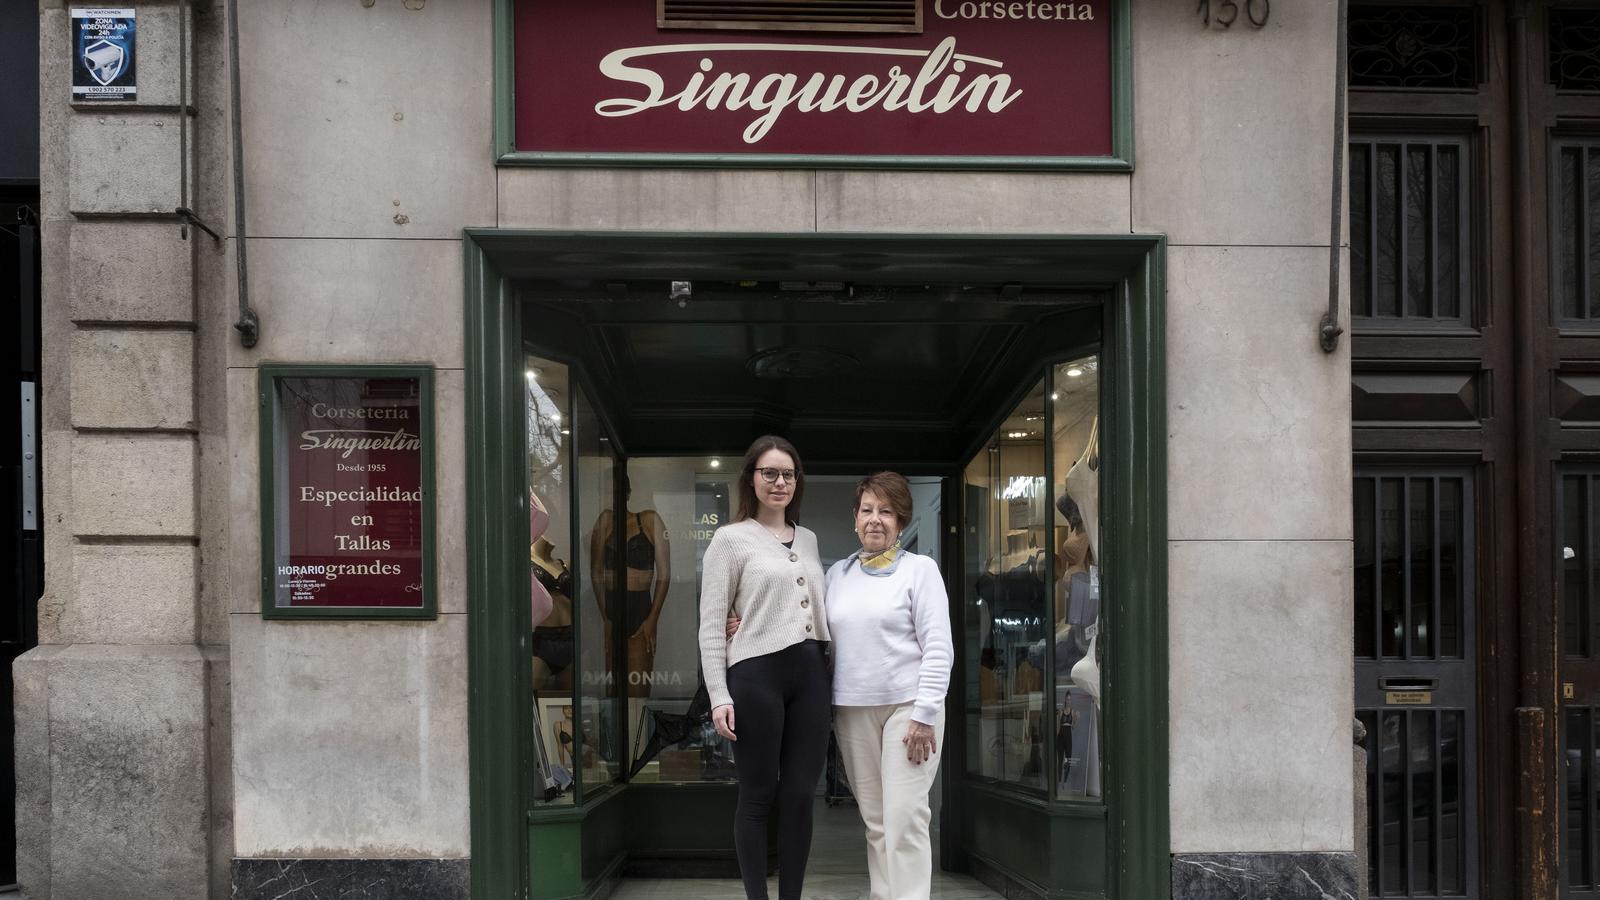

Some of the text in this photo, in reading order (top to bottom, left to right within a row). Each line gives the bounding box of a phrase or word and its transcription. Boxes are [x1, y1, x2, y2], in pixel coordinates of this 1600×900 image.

[934, 0, 1095, 22] Corseteria
[594, 35, 1023, 144] Singuerlin
[311, 402, 410, 420] Corseteria
[299, 427, 422, 459] Singuerlin
[337, 463, 386, 472] Desde 1955
[299, 486, 422, 507] Especialidad
[351, 514, 374, 526] en
[335, 535, 391, 551] Tallas
[278, 565, 325, 576] HORARIO
[325, 559, 402, 580] grandes
